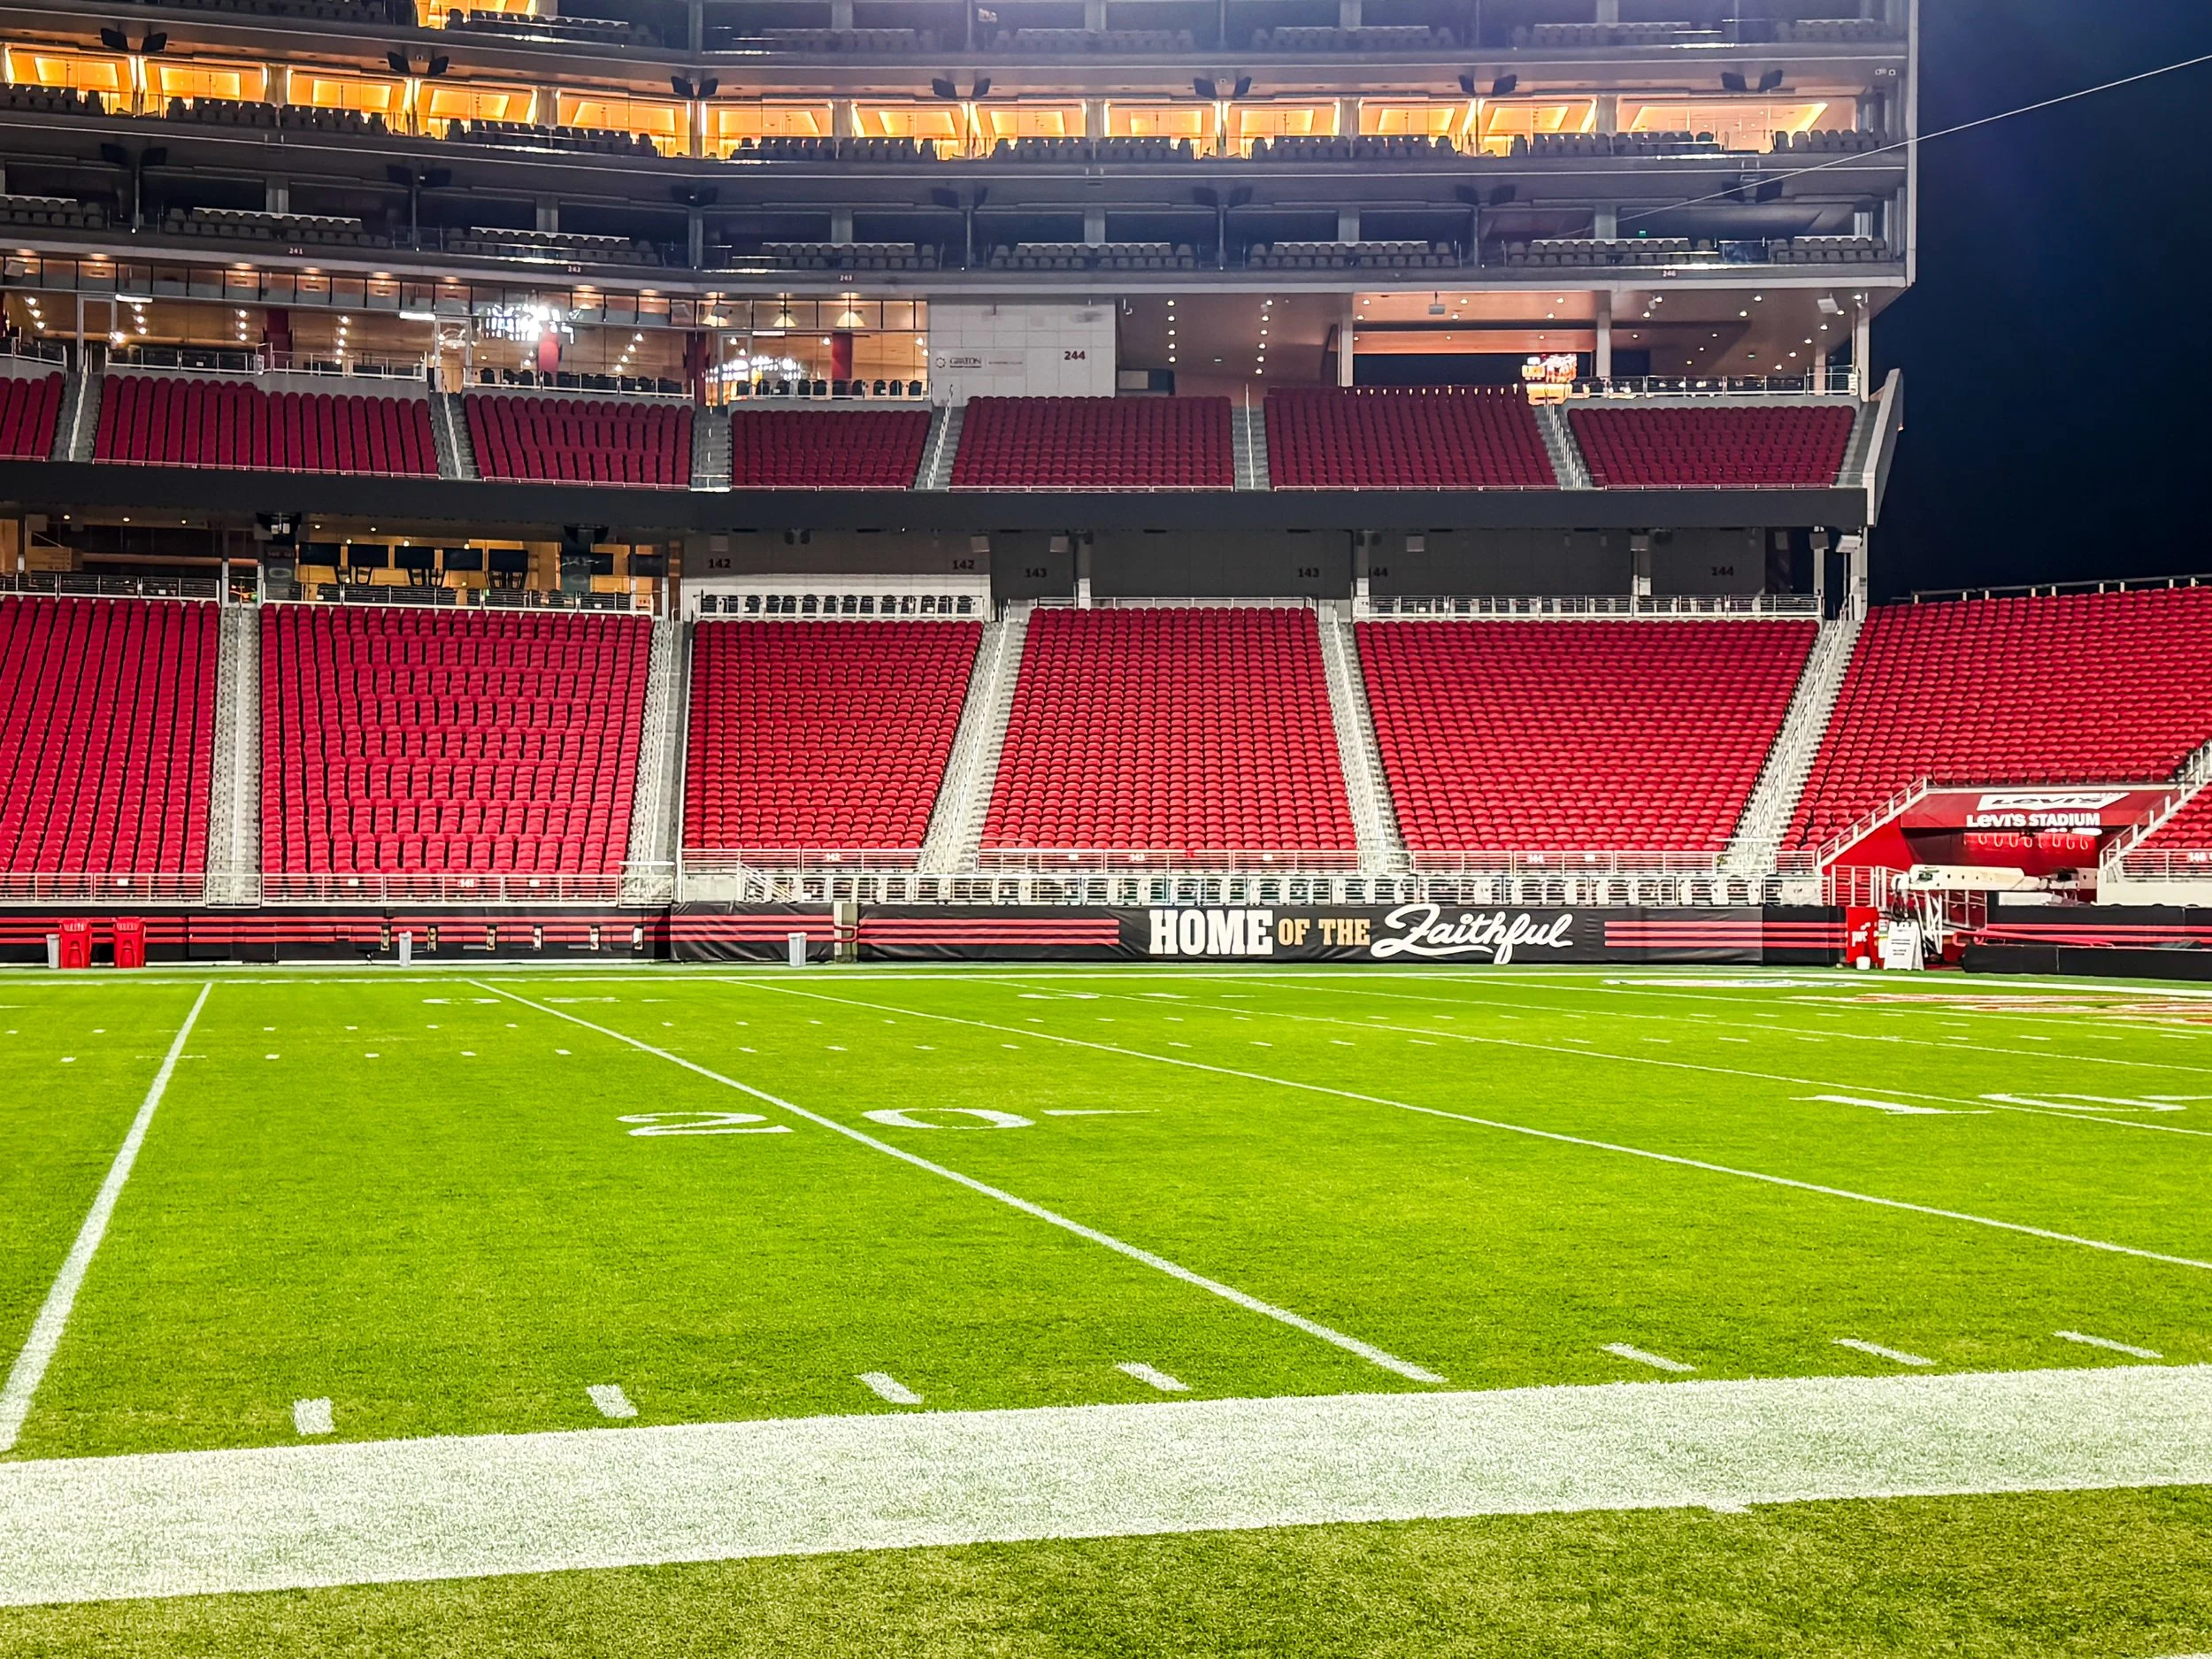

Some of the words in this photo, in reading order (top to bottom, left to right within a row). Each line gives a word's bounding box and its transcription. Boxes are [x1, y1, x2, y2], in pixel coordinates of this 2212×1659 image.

[1064, 350, 1087, 360] 244
[708, 558, 732, 569] 142
[952, 559, 975, 570] 142
[1025, 568, 1048, 578] 143
[1298, 568, 1319, 578] 143
[2029, 812, 2101, 827] STADIUM
[1148, 910, 1273, 956] HOME
[1278, 921, 1311, 947] OF
[1318, 918, 1371, 947] THE
[1371, 903, 1573, 964] Faithful
